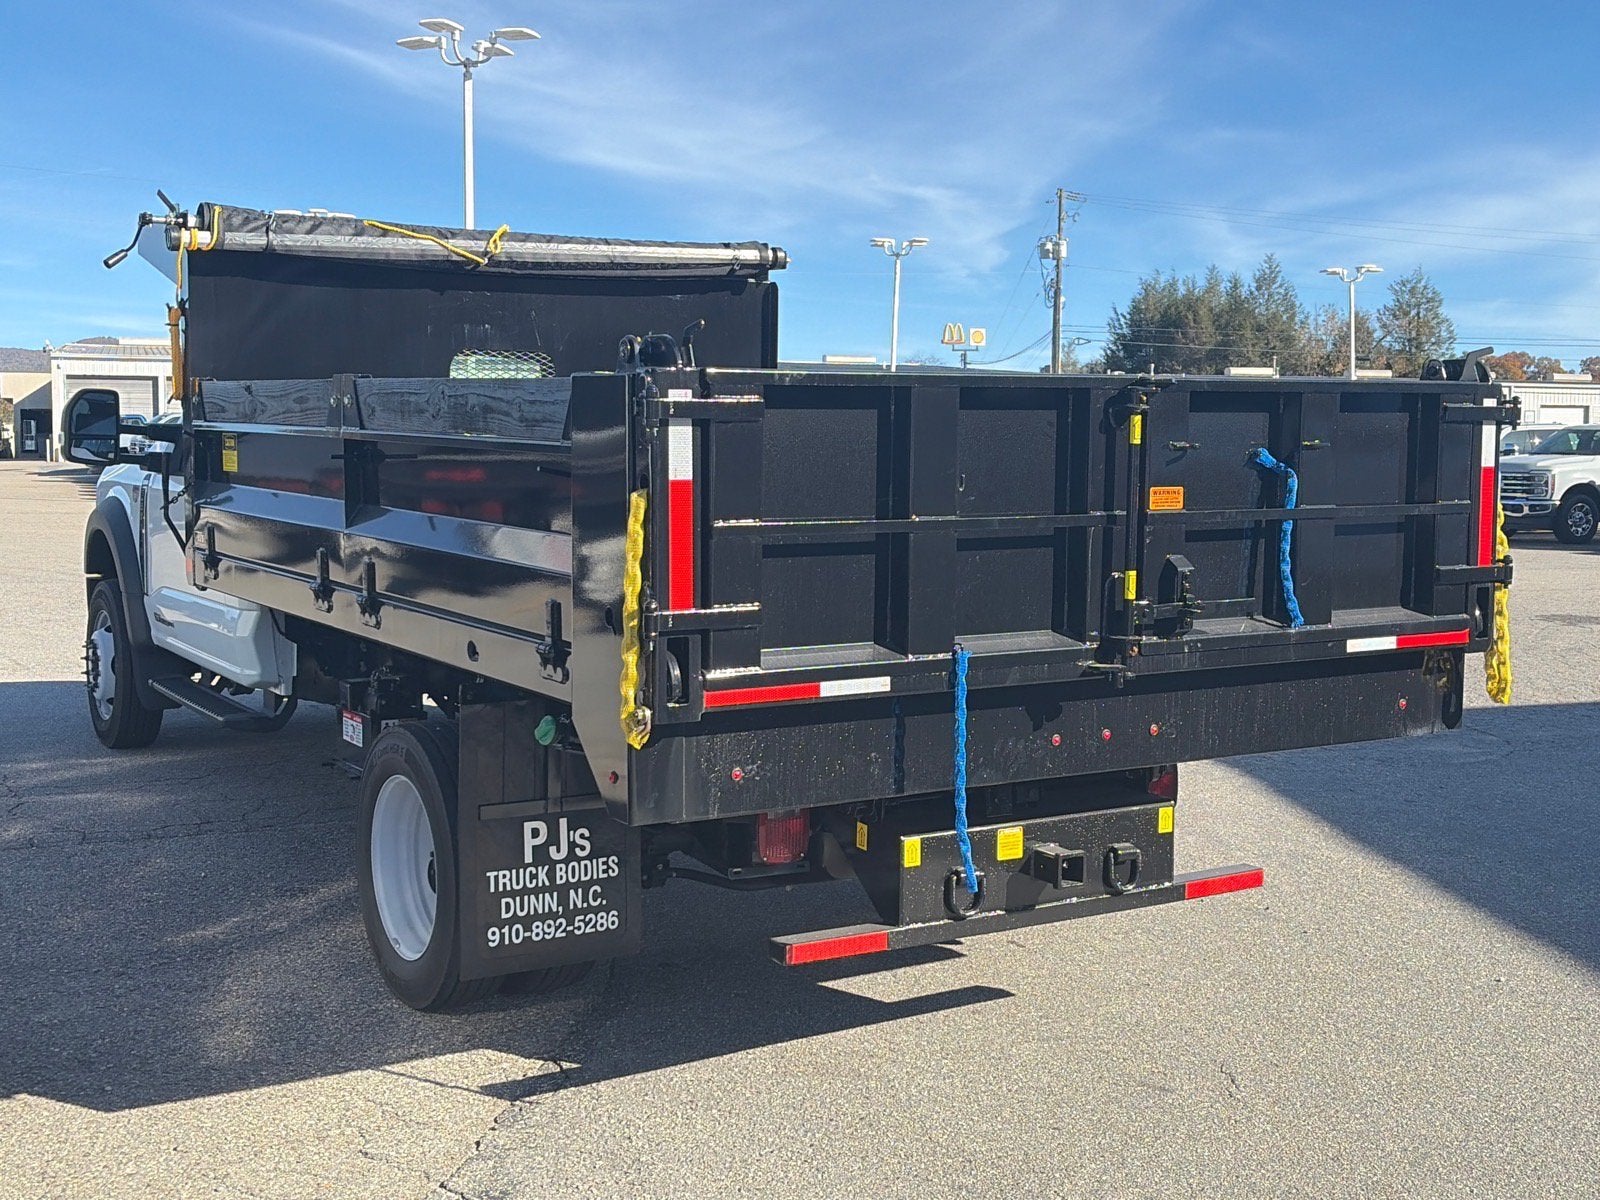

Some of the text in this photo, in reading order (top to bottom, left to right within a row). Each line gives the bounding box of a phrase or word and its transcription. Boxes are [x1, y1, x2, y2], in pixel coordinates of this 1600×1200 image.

[486, 855, 619, 893] TRUCK BODIES
[500, 885, 607, 919] DUNN, N.C.
[487, 910, 619, 948] 910-892-5286
